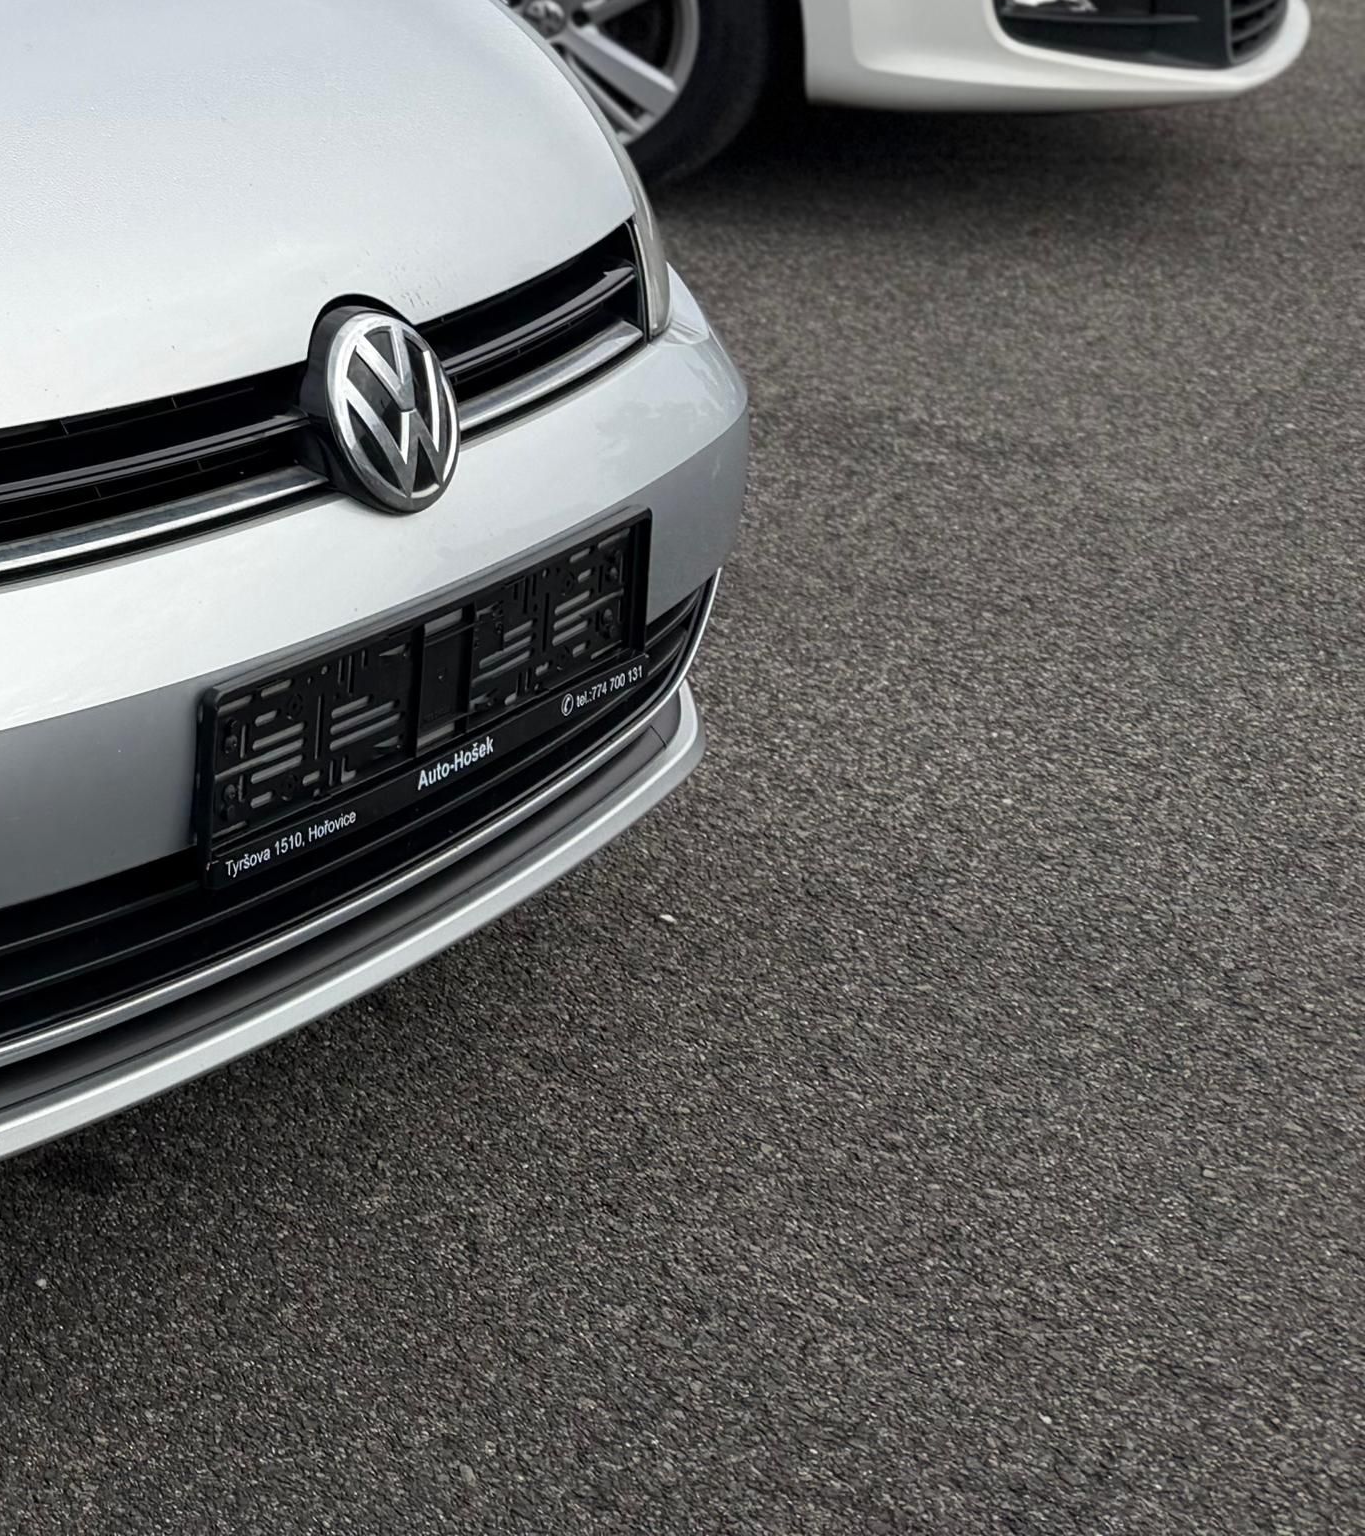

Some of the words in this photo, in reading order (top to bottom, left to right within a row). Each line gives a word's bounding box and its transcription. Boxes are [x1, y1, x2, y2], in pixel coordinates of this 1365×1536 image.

[610, 672, 626, 692] 700
[628, 664, 643, 683] 131
[417, 735, 494, 791] Auto-Hošek
[225, 847, 271, 878] Tyršova
[308, 811, 357, 843] Hořovice
